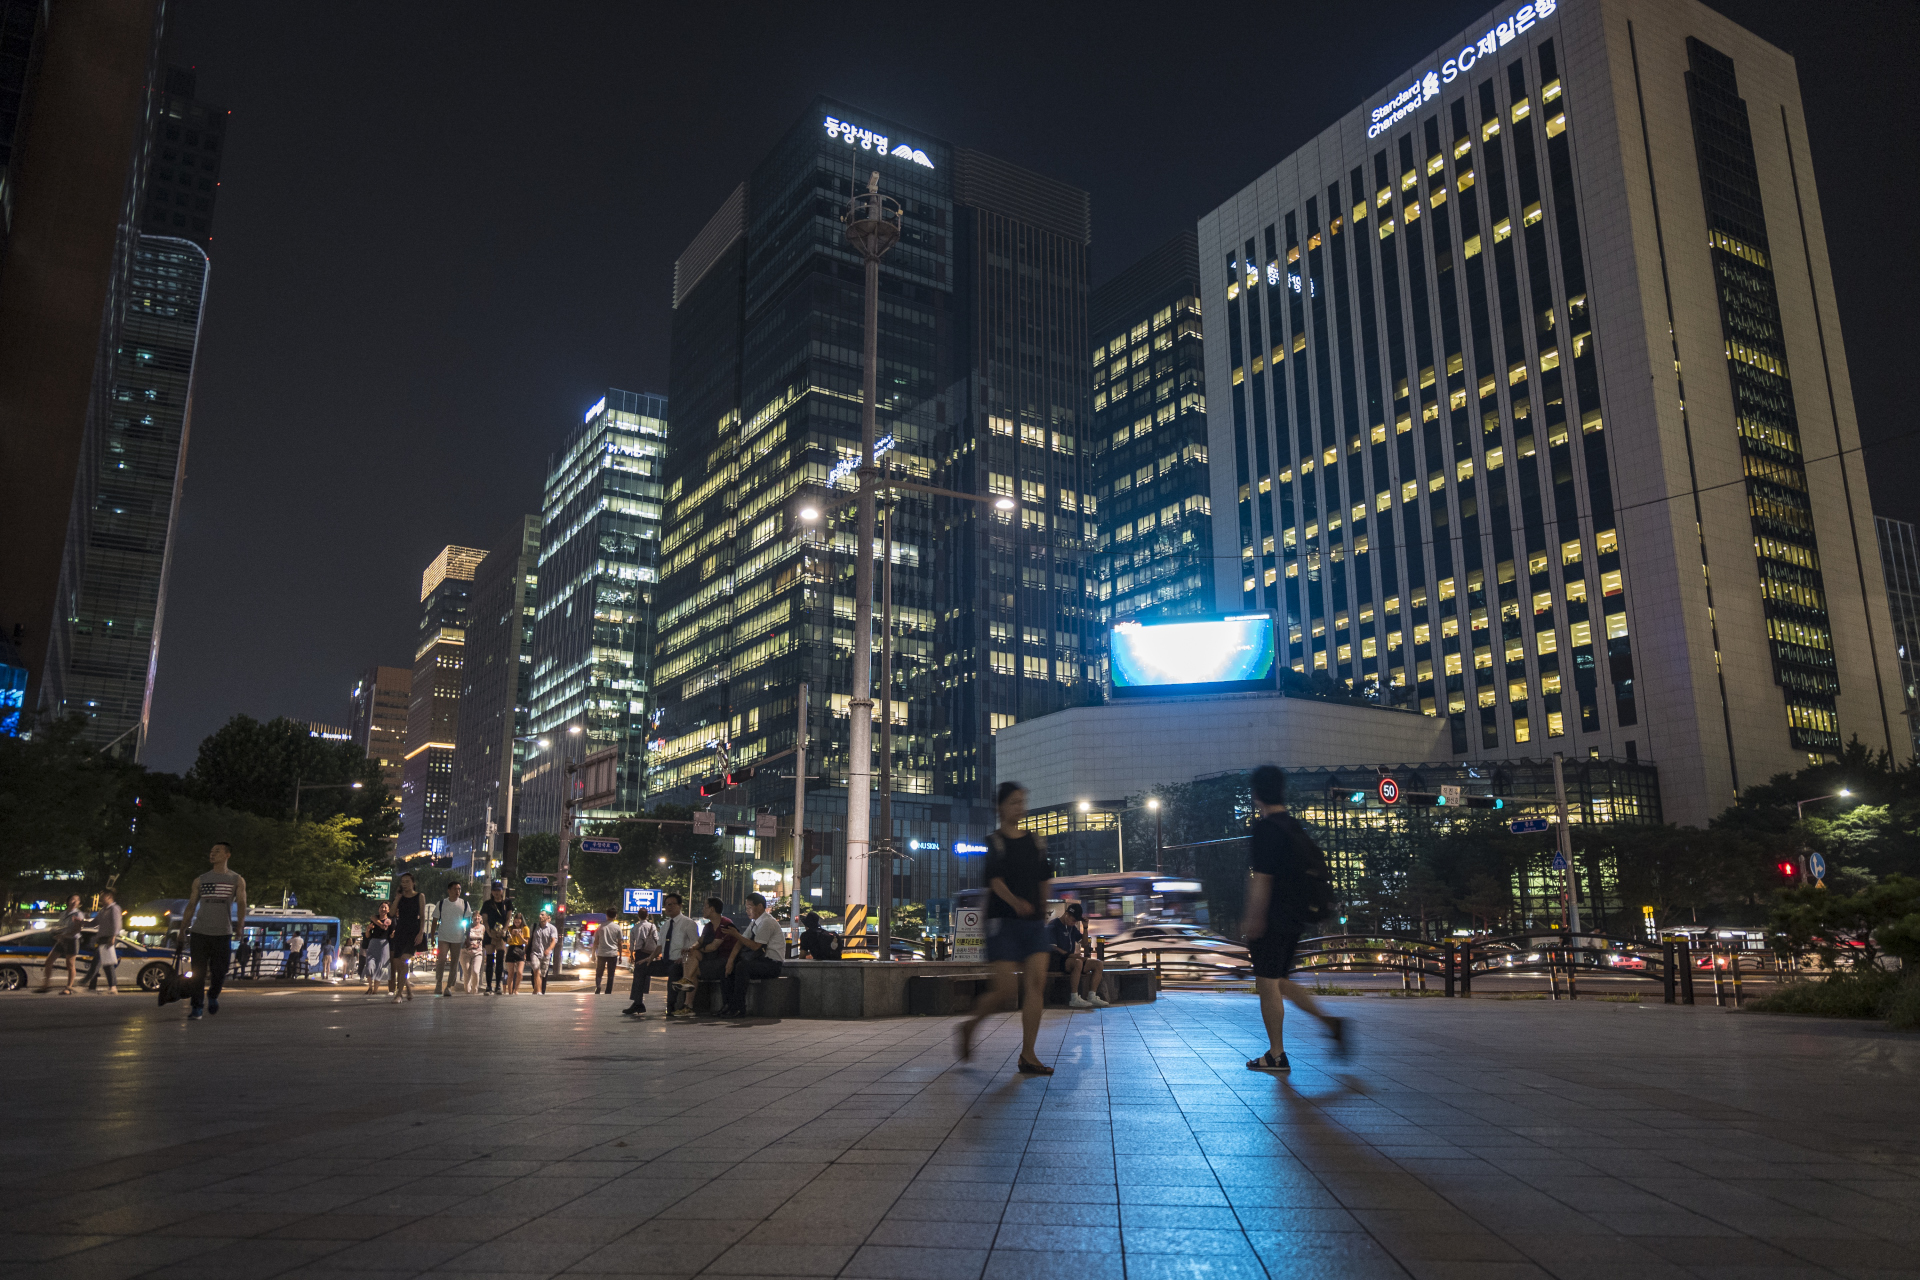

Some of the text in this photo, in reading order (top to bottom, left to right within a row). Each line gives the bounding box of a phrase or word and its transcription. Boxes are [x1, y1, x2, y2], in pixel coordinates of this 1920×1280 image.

[1441, 0, 1557, 84] SC제일은행
[1367, 93, 1423, 139] Chartered
[1371, 79, 1421, 123] Standard
[823, 115, 888, 156] 동양생명
[1383, 784, 1395, 797] 50
[918, 842, 939, 850] NU SKIN
